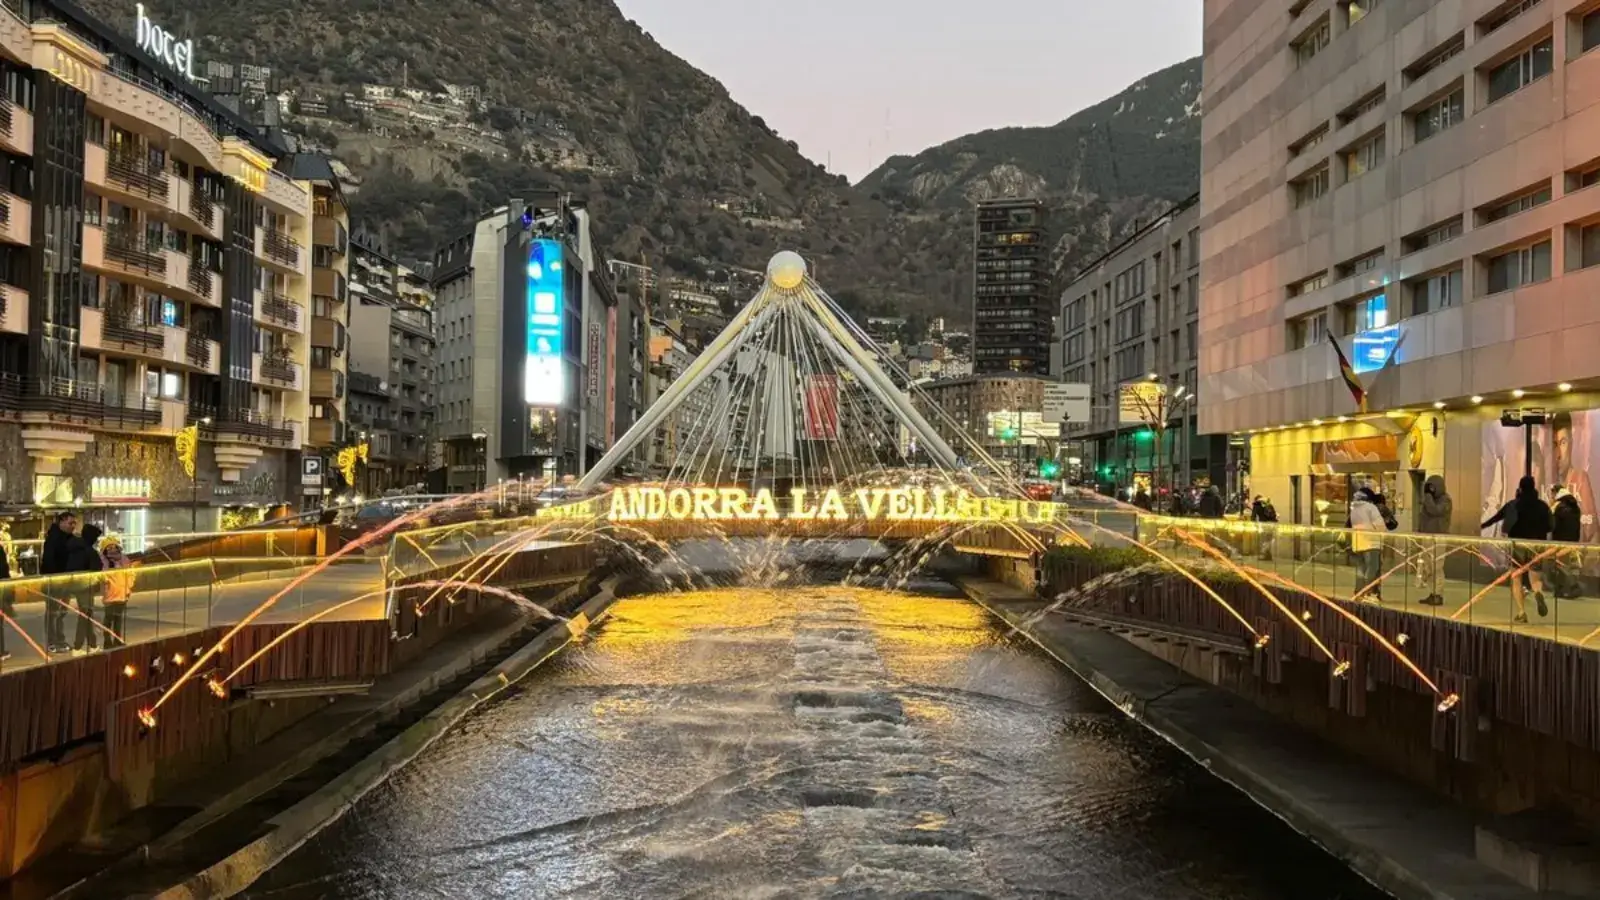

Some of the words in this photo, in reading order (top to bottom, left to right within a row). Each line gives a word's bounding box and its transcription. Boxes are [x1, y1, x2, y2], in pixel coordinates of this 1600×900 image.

[306, 460, 318, 473] P
[607, 486, 780, 520] ANDORRA
[787, 487, 849, 520] LA
